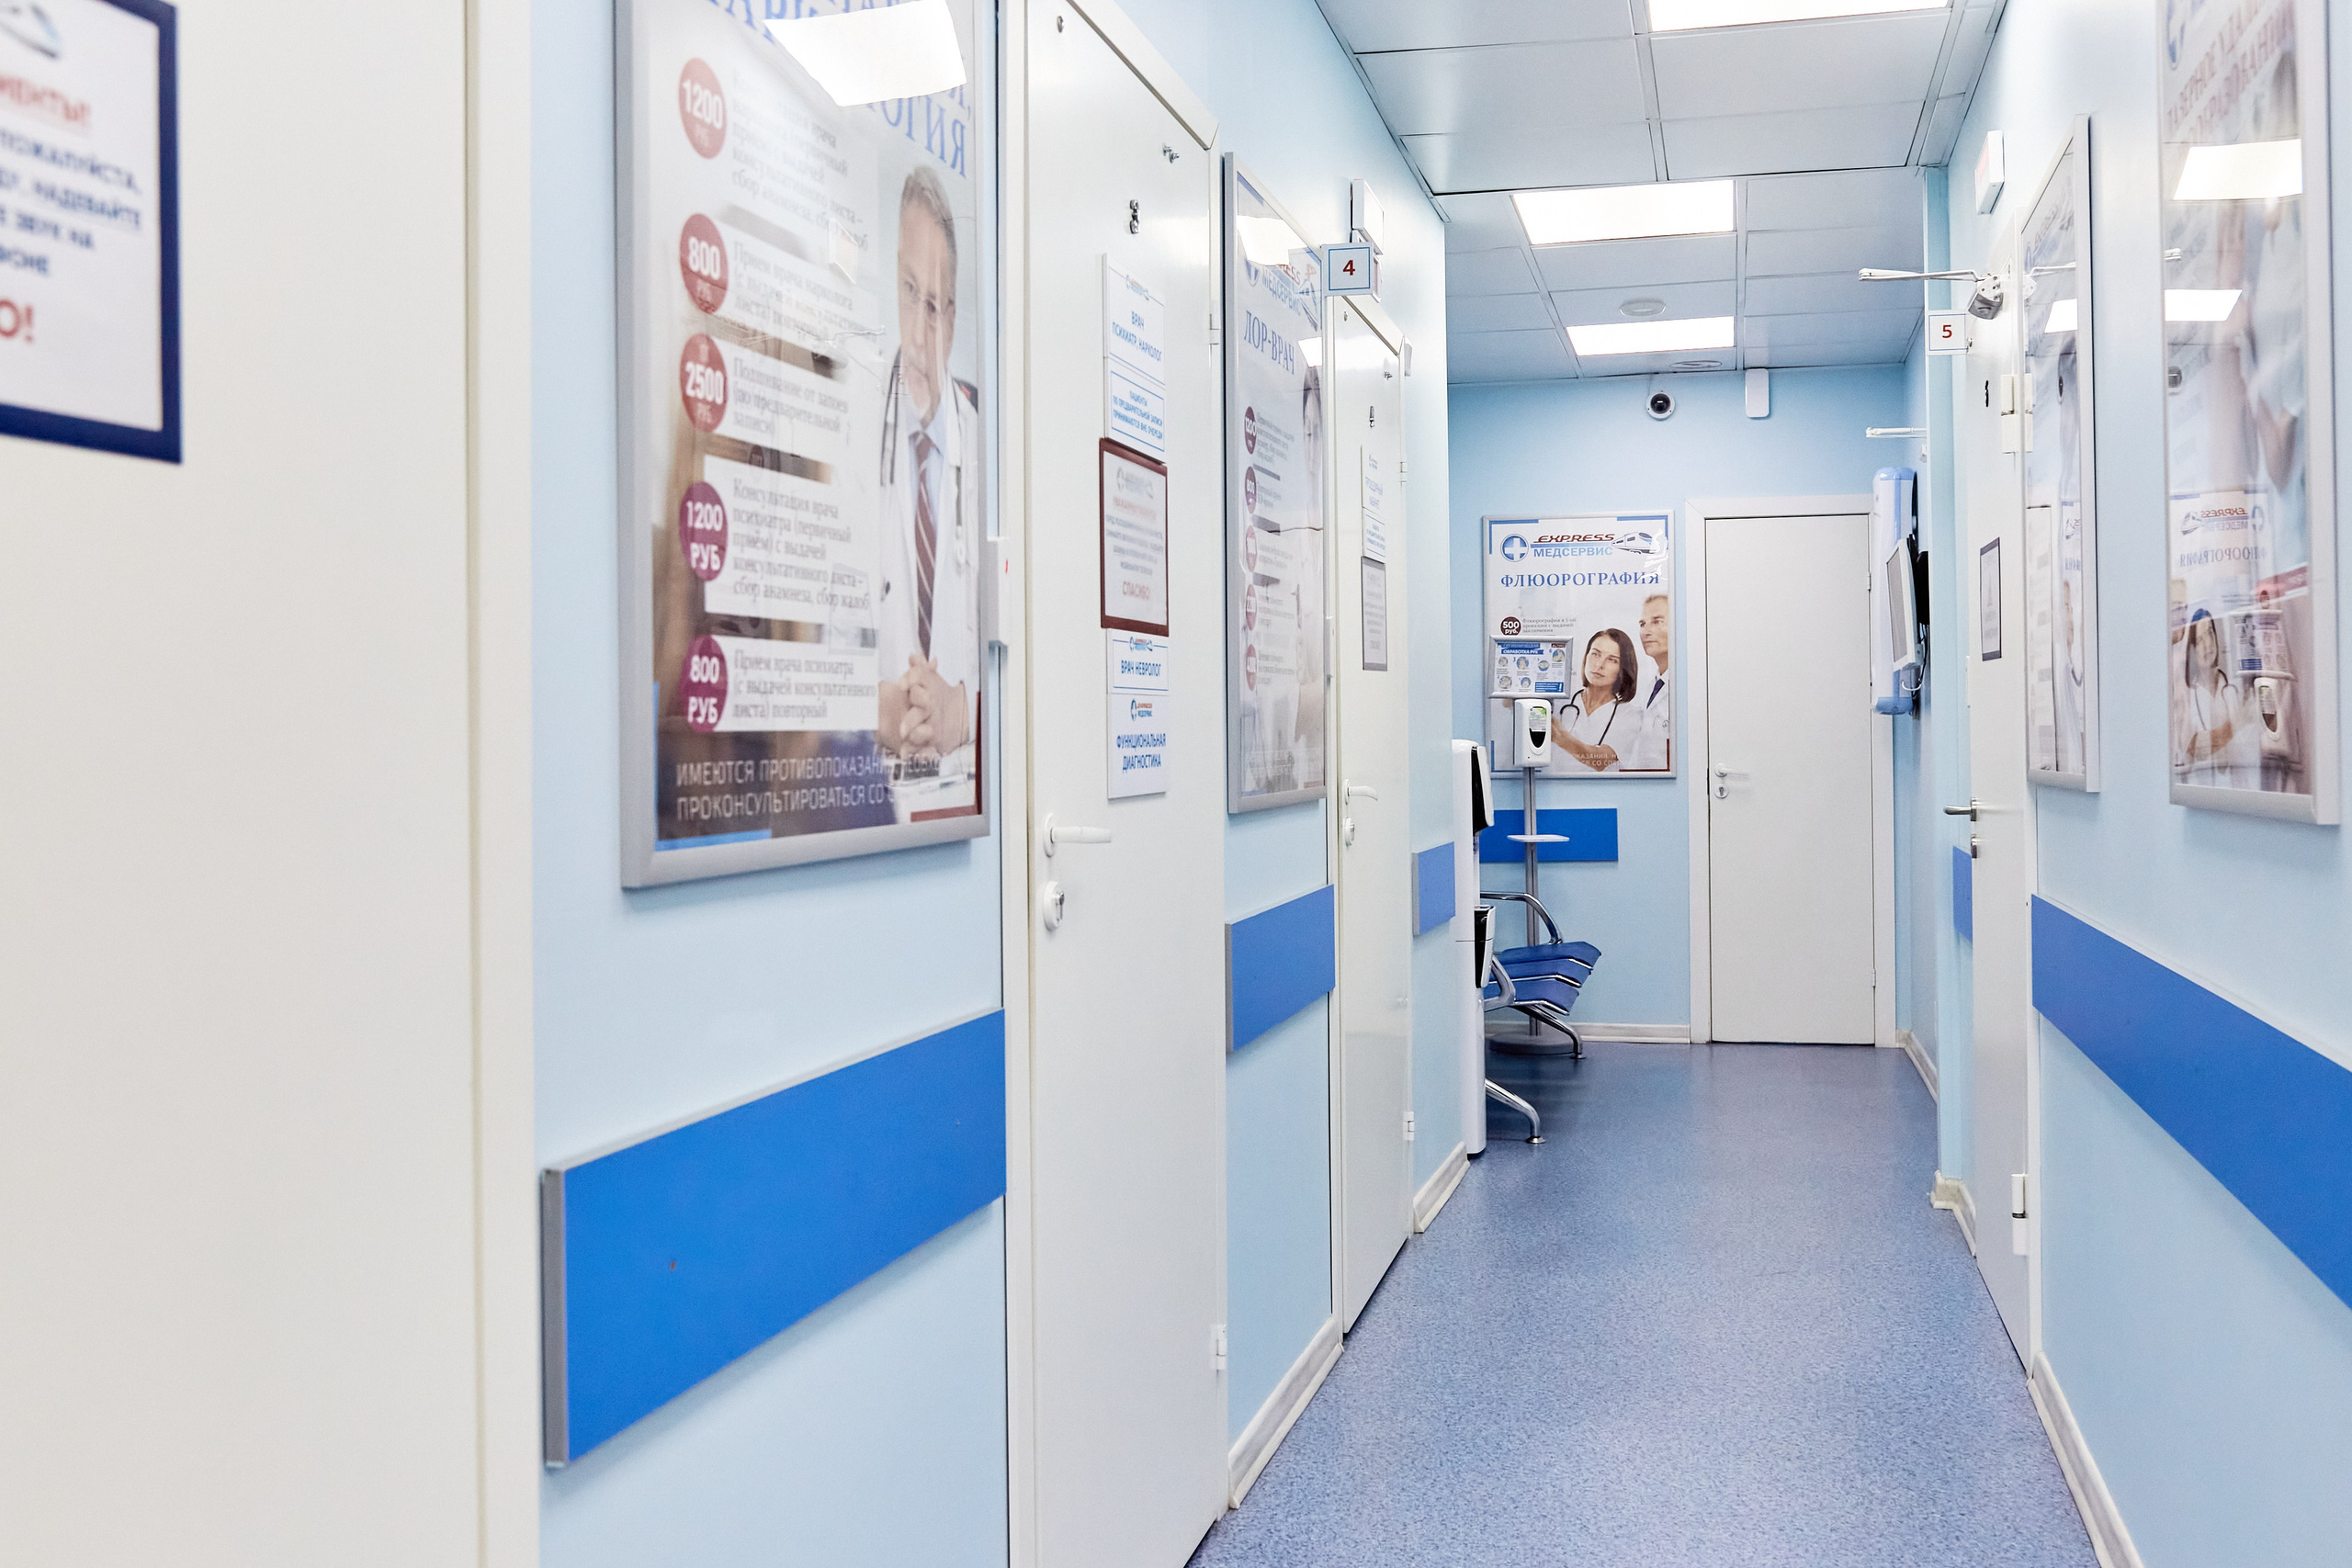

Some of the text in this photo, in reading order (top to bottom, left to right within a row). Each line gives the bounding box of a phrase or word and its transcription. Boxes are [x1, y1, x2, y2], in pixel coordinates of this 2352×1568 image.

[683, 77, 723, 130] 1200
[688, 235, 720, 280] 800
[1342, 259, 1355, 276] 4
[1131, 310, 1145, 332] ВРАЧ
[1941, 324, 1952, 338] 5
[1243, 310, 1295, 375] ЛОР-ВРАЧ
[684, 361, 724, 405] 2500
[685, 501, 723, 531] 1200
[1533, 534, 1615, 544] EXPRESS
[1533, 547, 1613, 558] МЕДСЕРВИС
[690, 542, 721, 570] РУБ
[1500, 571, 1660, 588] ФЛЮОРОГРАФИЯ
[690, 654, 720, 684] 800
[1121, 660, 1161, 677] ВРАЧ НЕВРОЛОГ
[688, 695, 718, 724] РУБ
[1116, 733, 1167, 751] ФУНКЦИОНАЛЬНАЯ
[676, 759, 754, 787] ИМЕЮТСЯ
[1122, 753, 1161, 773] ДИАГНОСТИКА
[676, 784, 865, 821] ПРОКОНСУЛЬТИРОВАТЬСЯ
